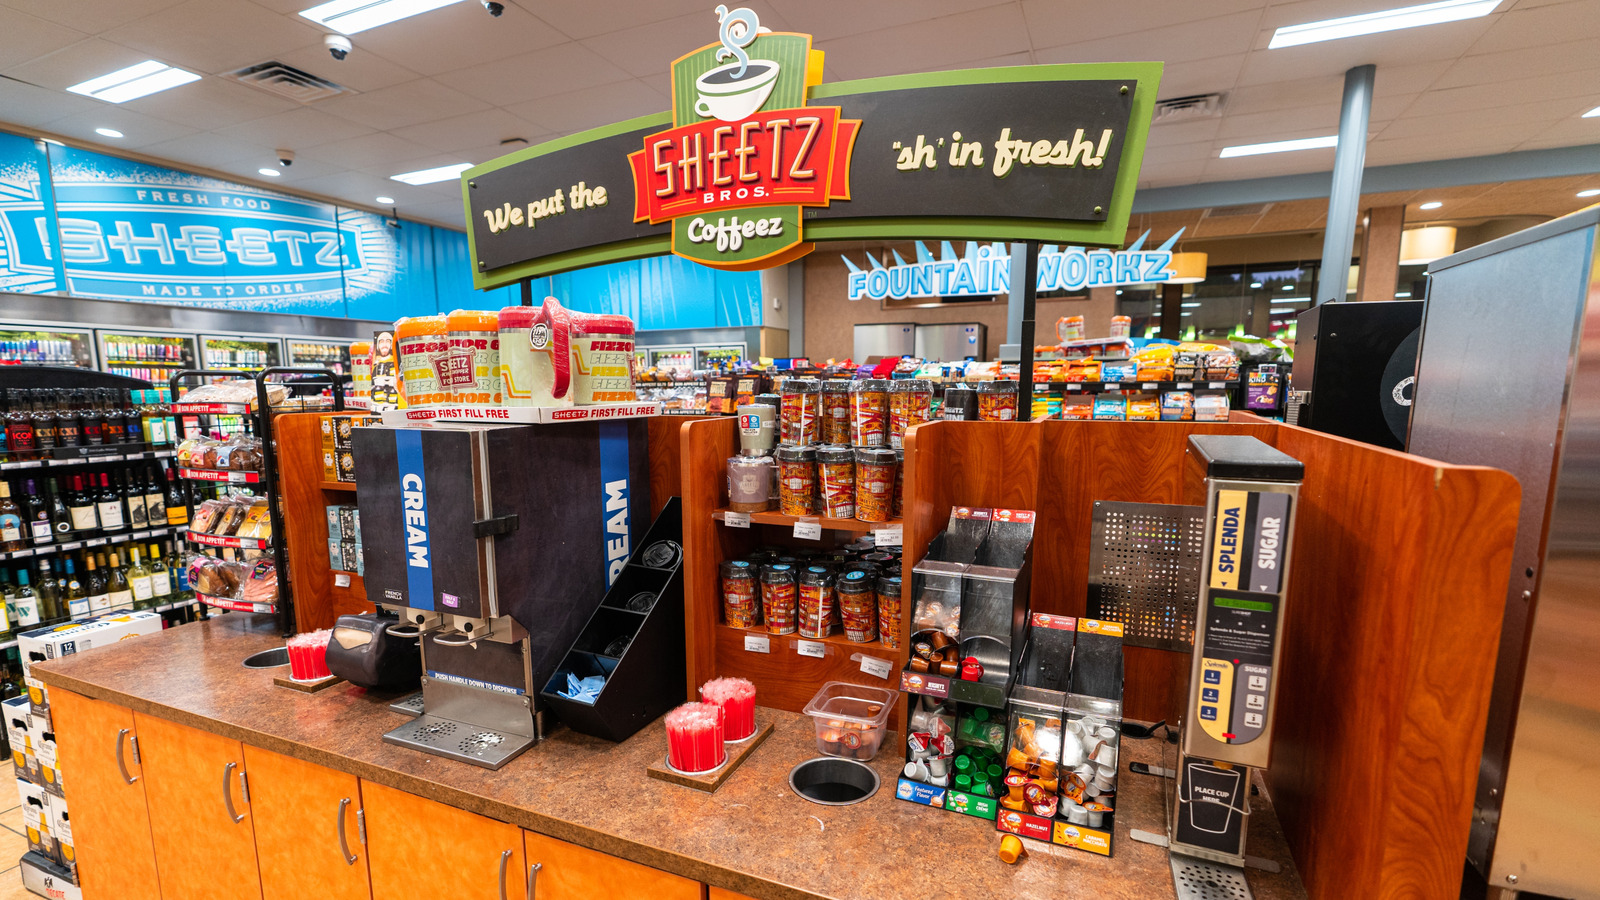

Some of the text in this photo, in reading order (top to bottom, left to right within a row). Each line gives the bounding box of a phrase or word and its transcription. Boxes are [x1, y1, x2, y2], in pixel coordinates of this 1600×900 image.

[654, 116, 822, 198] SHEETZ
[949, 131, 983, 167] in
[992, 127, 1113, 178] fresh!
[137, 190, 271, 211] FRESH FOOD
[703, 186, 770, 204] BROS.
[483, 181, 607, 234] We put the
[687, 216, 783, 252] Coffeez
[35, 217, 350, 268] SHEETZ
[142, 283, 304, 297] MADE TO ORDER
[438, 409, 462, 418] FIRST
[465, 409, 484, 418] FILL
[486, 409, 509, 418] FREE
[554, 406, 655, 419] SHEETZ FIRST FILL FREE
[402, 473, 429, 568] CREAM
[206, 537, 225, 545] APPETIT
[1219, 507, 1240, 573] SPLENDA
[1258, 517, 1281, 570] SUGAR
[64, 643, 73, 651] 12
[1204, 660, 1228, 668] Splenda
[1244, 665, 1267, 674] SUGAR
[448, 674, 468, 685] HANDLE
[468, 679, 484, 688] DOWN
[493, 684, 517, 694] DISPENSE
[914, 786, 933, 794] Featured
[1194, 786, 1229, 798] PLACE CUP
[1026, 823, 1048, 831] HAZELNUT
[1083, 838, 1107, 847] MACCHIATO
